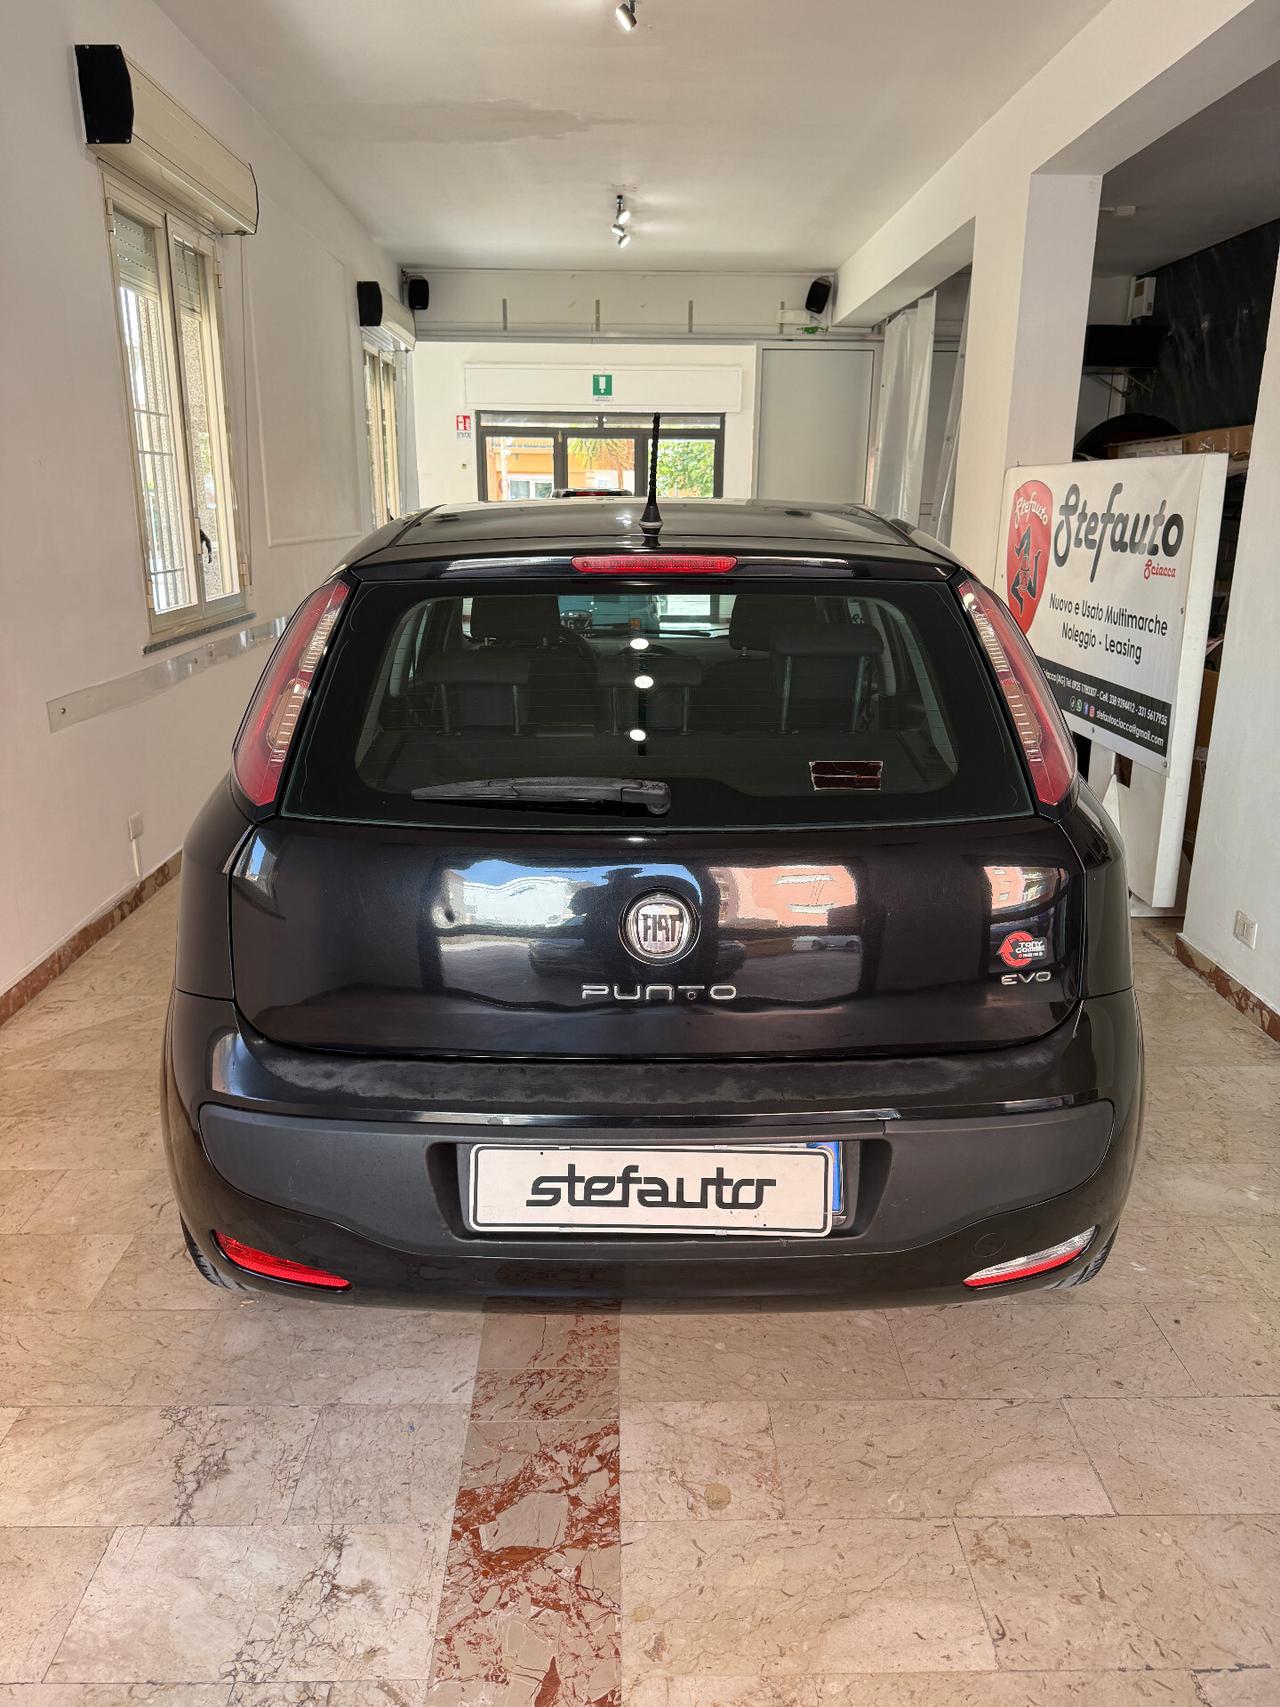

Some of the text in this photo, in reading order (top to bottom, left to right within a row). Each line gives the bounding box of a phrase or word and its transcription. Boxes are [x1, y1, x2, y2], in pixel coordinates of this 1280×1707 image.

[1015, 491, 1048, 529] Stefauto
[1053, 483, 1184, 583] Stefauto
[1143, 559, 1176, 580] Sciacca
[1049, 593, 1168, 637] Nuovo e Usato Multimarche
[1061, 622, 1097, 650] Noleggio
[1104, 634, 1142, 665] Leasing
[642, 914, 683, 942] FIAT
[582, 983, 737, 1001] PUNTO
[1001, 971, 1052, 985] EVO
